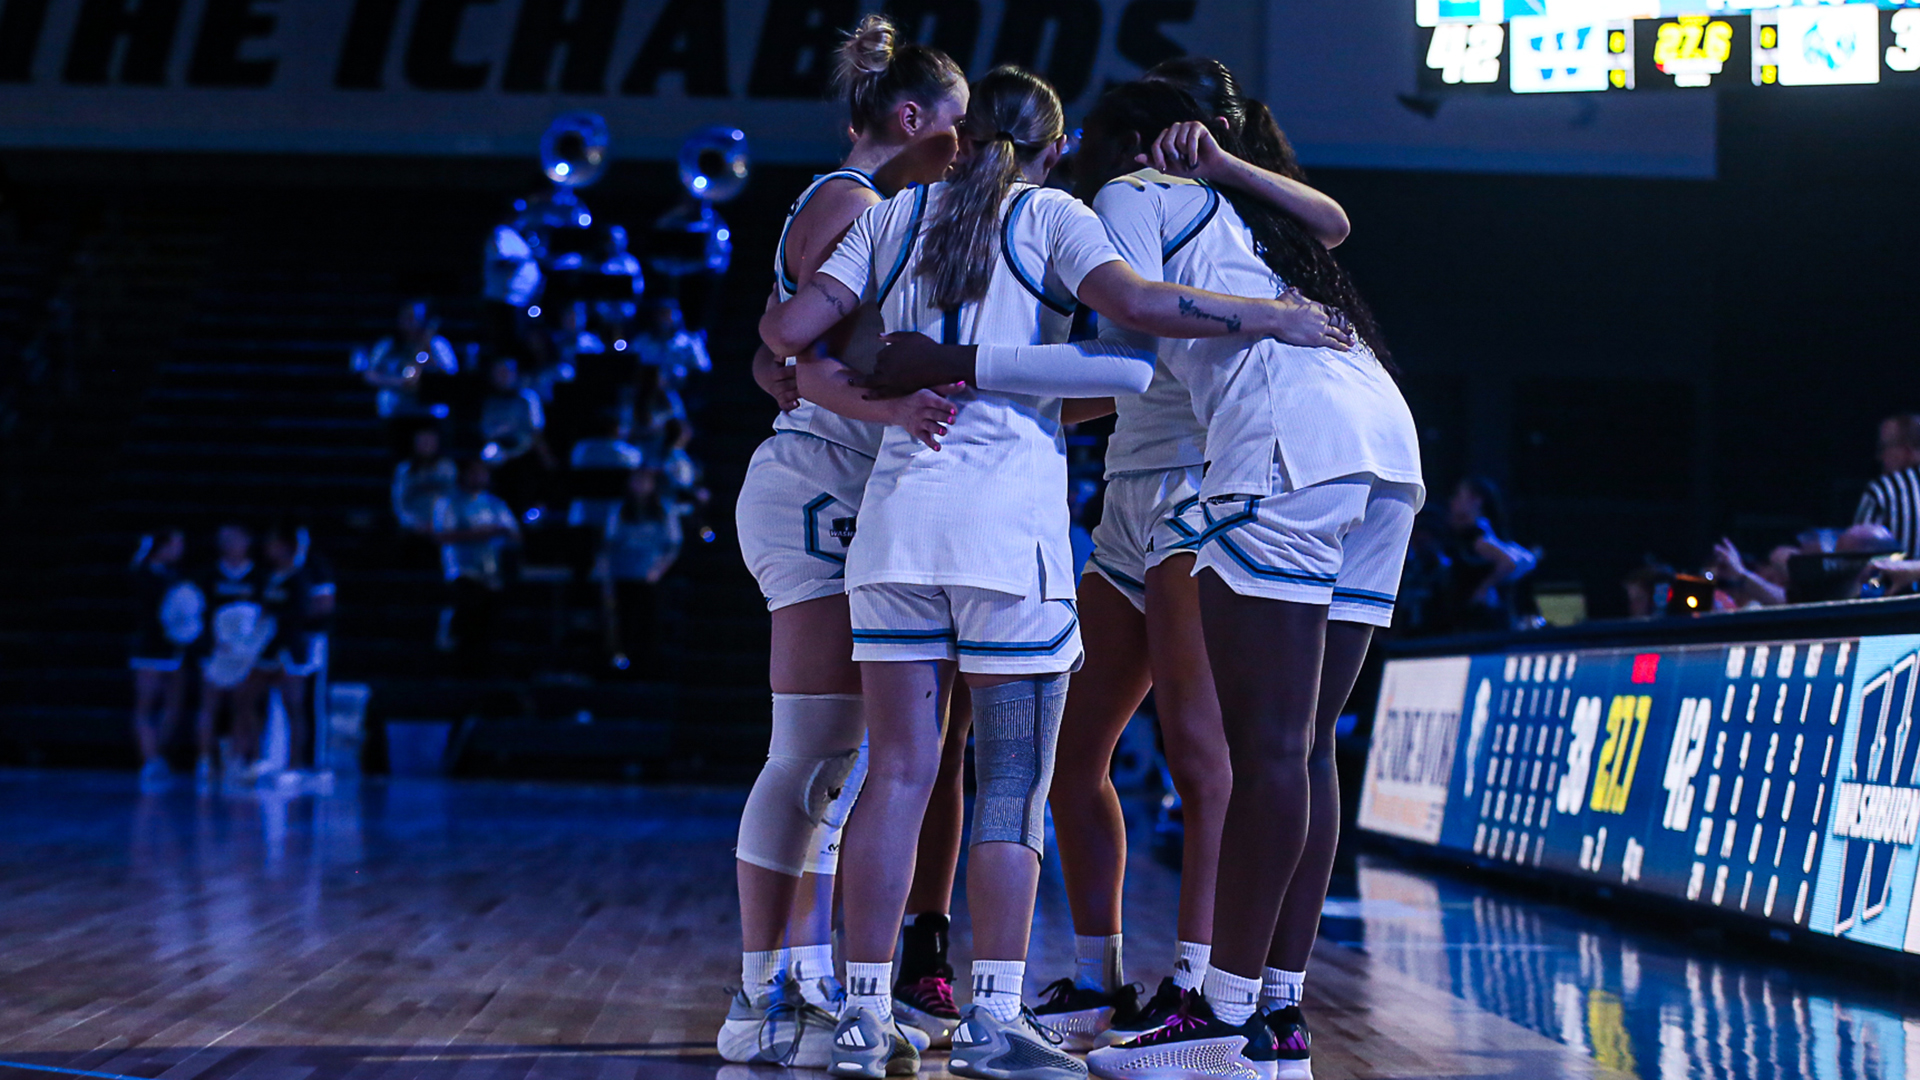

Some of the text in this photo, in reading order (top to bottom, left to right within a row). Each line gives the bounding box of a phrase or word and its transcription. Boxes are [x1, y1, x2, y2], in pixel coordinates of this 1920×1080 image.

[1426, 24, 1504, 83] 42
[830, 529, 857, 538] WASH
[1662, 697, 1712, 832] 42
[1832, 780, 1920, 845] WASHBURN
